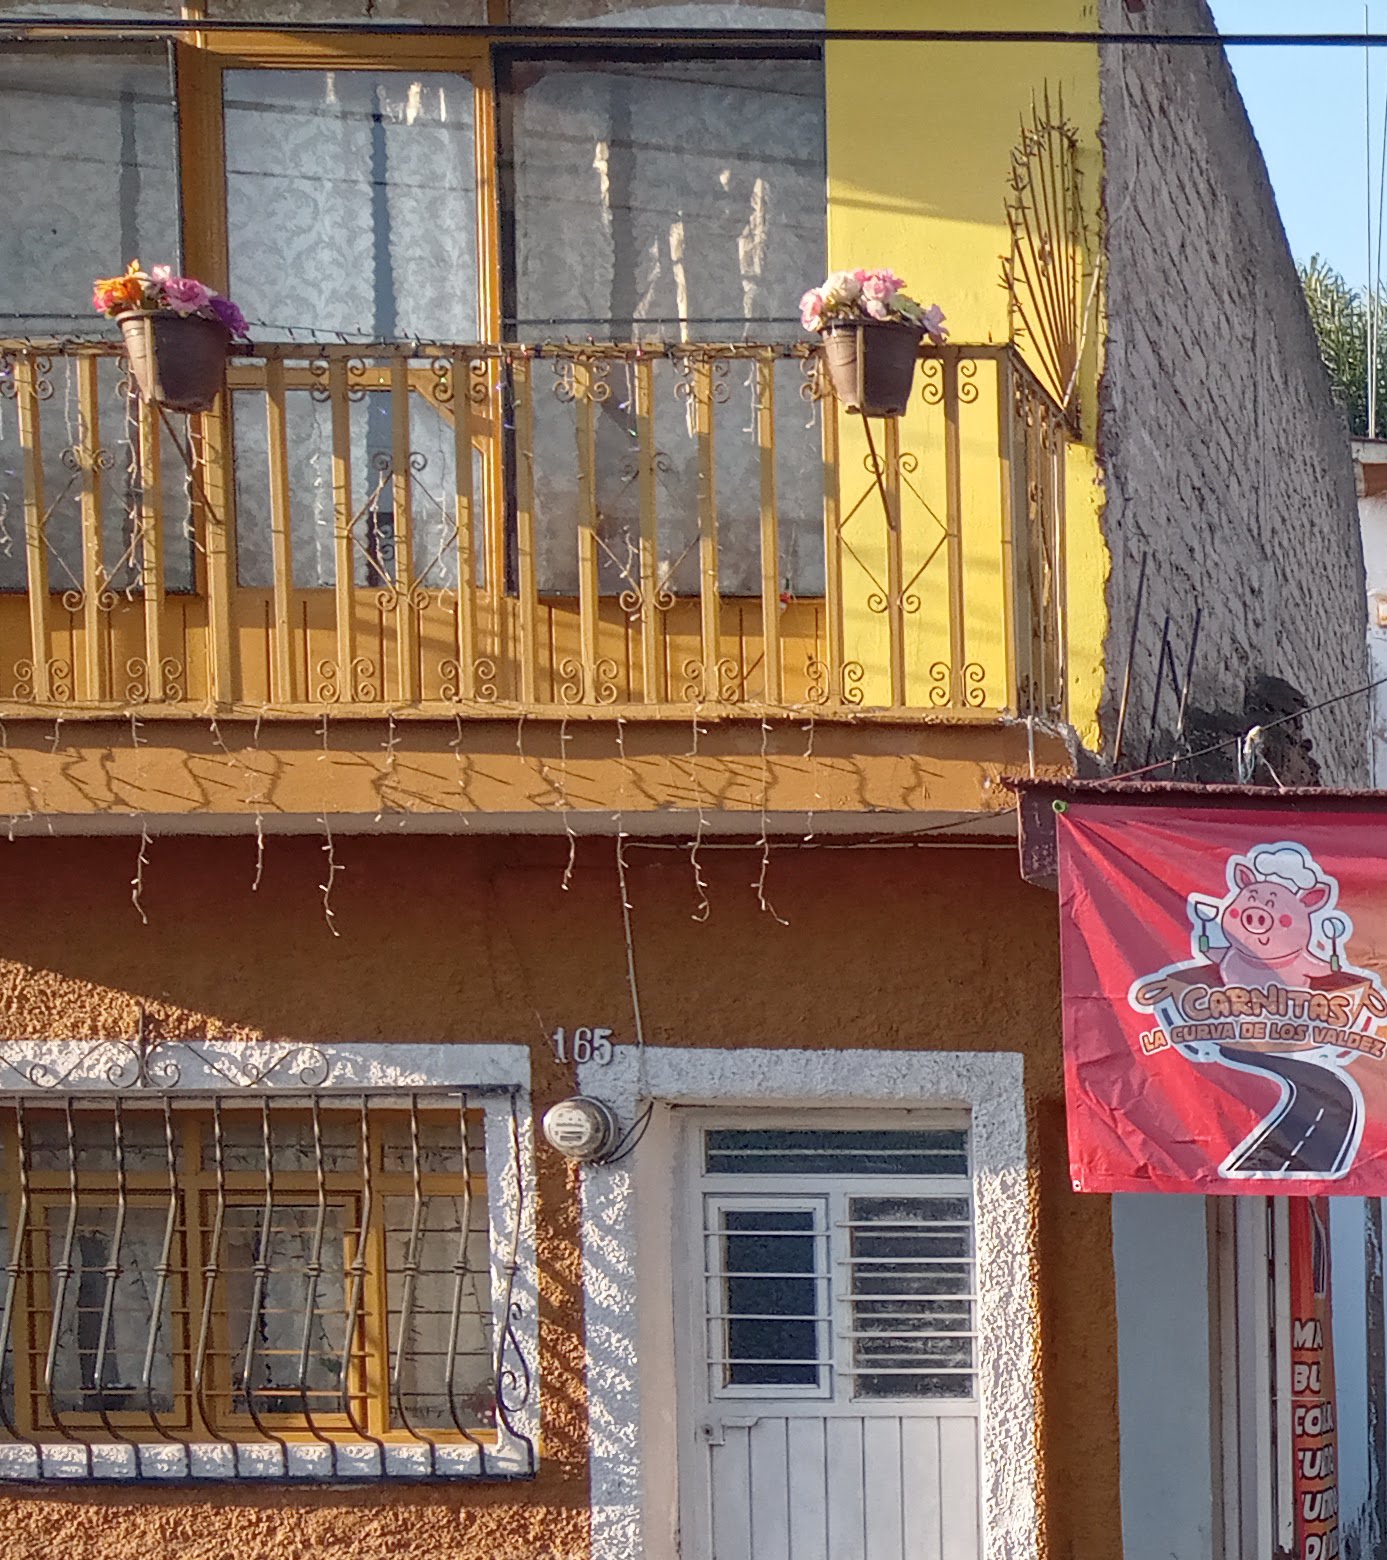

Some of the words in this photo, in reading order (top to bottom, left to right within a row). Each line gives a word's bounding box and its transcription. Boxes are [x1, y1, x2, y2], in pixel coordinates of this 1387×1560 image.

[1181, 985, 1350, 1028] CARNITAS
[552, 1026, 614, 1066] 165
[1143, 1030, 1168, 1054] LA
[1170, 1022, 1235, 1043] CURVA
[1239, 1021, 1266, 1040] DE
[1270, 1022, 1309, 1040] LOS
[1312, 1025, 1387, 1058] VALDEZ
